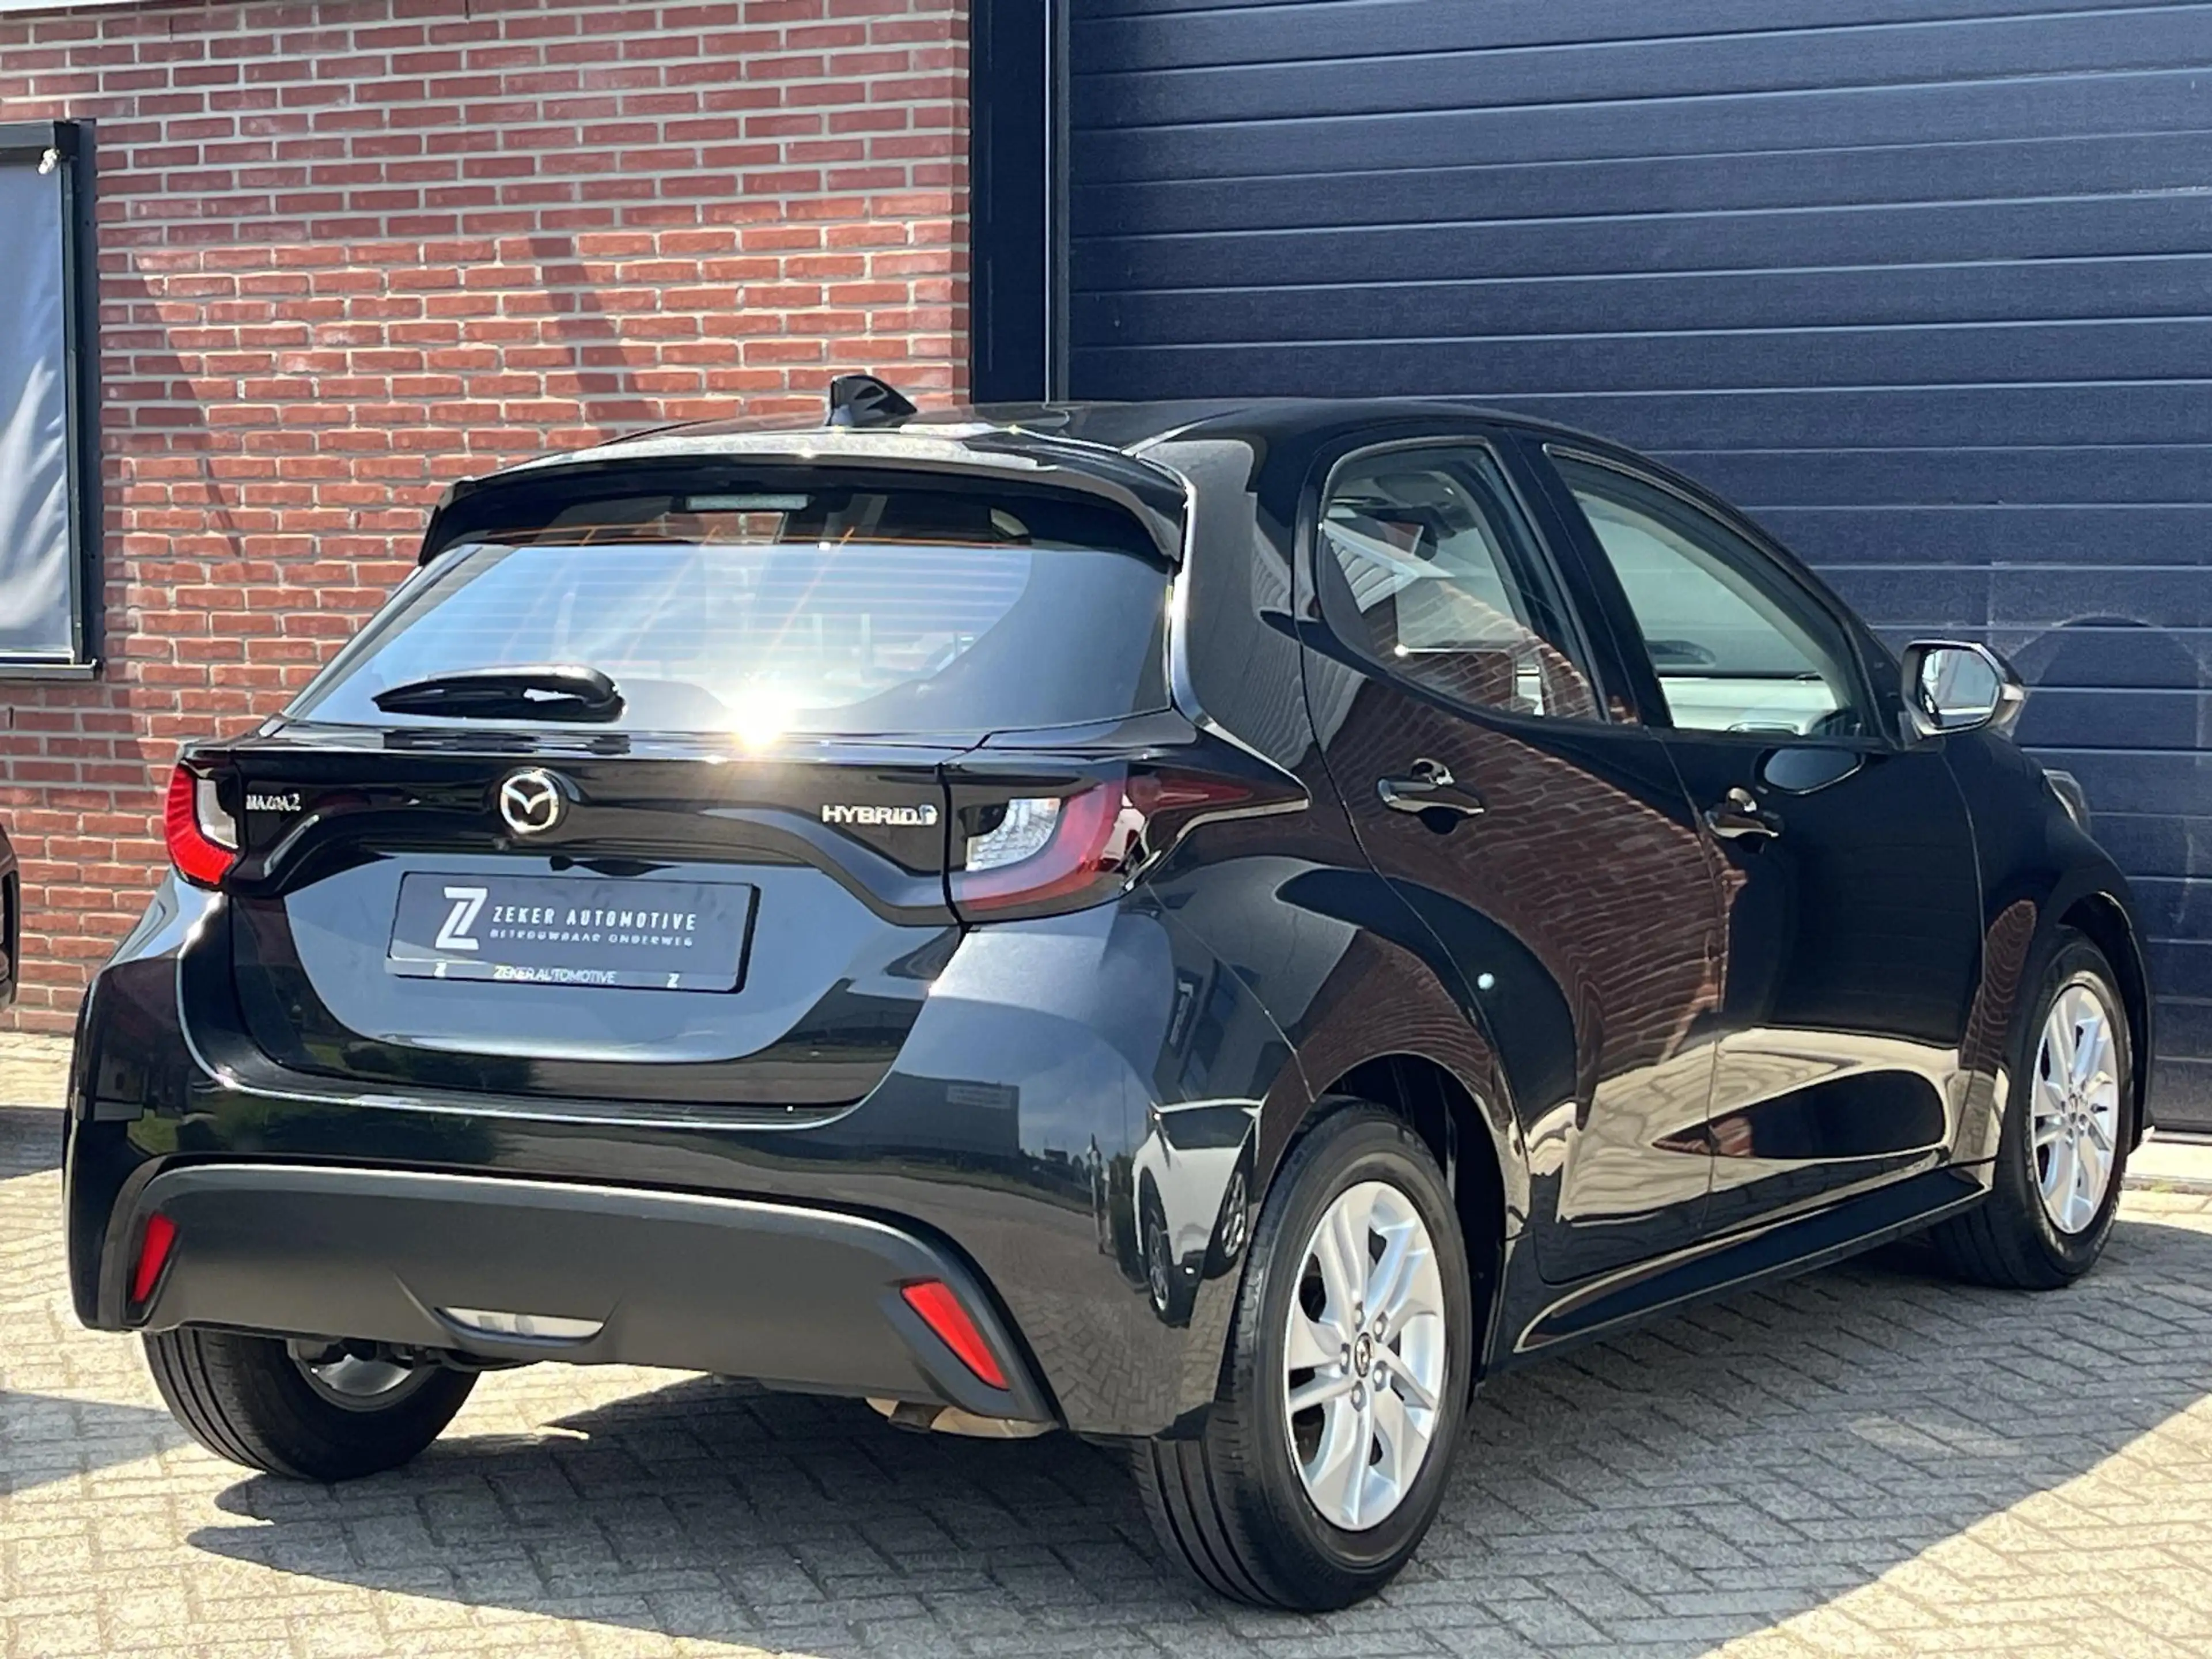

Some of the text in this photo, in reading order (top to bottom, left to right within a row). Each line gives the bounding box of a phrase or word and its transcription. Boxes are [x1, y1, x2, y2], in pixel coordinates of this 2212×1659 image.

[822, 805, 918, 824] HYBRID
[435, 887, 488, 950] Z
[493, 906, 697, 931] ZEKER AUTOMOTIVE
[493, 965, 535, 981] ZEKER
[536, 968, 617, 984] AUTOMOTIVE
